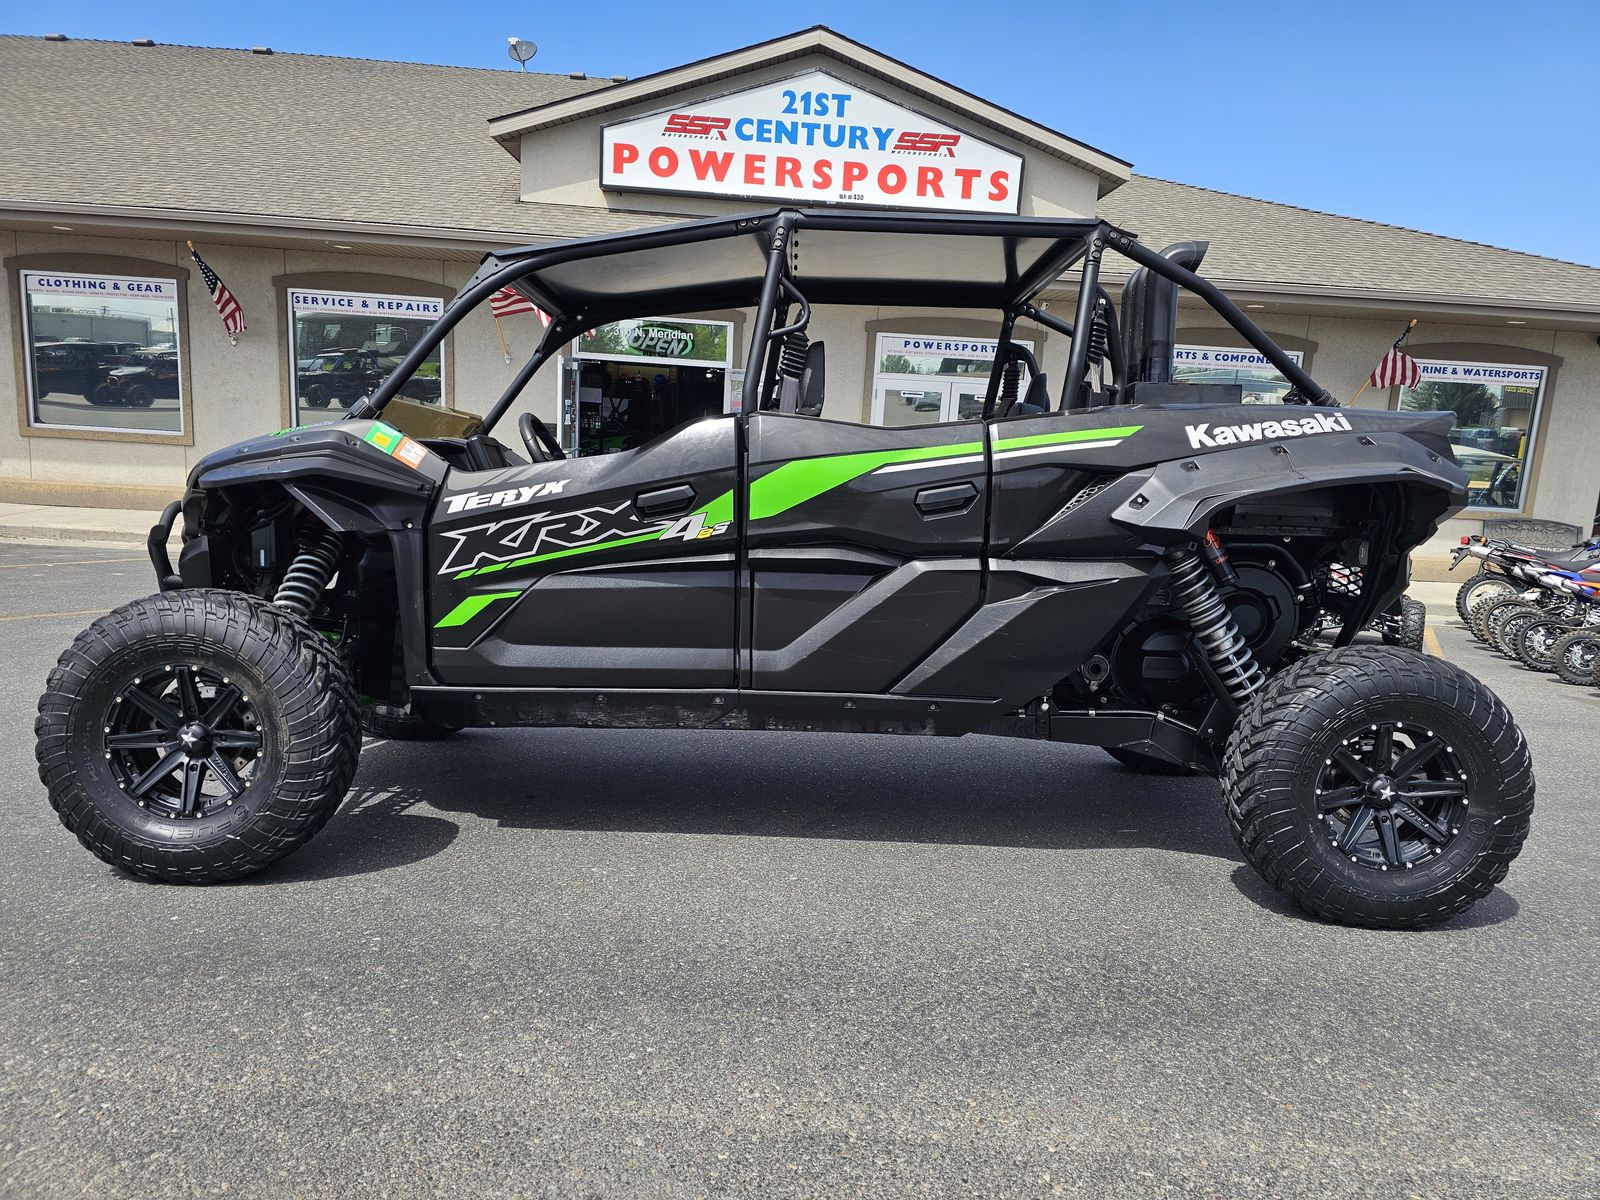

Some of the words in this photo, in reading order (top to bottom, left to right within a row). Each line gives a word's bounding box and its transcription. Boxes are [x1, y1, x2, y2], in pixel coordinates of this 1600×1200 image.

[782, 89, 852, 118] 21ST
[663, 114, 731, 141] SSR
[734, 117, 895, 151] CENTURY
[893, 132, 961, 158] SSR
[612, 142, 1009, 202] POWERSPORTS
[38, 279, 106, 290] CLOTHING
[112, 282, 121, 291] &
[127, 283, 163, 293] GEAR
[294, 295, 354, 308] SERVICE
[361, 300, 370, 309] &
[377, 301, 439, 313] REPAIRS
[628, 331, 687, 356] OPEN
[635, 327, 646, 338] N.
[649, 328, 694, 340] Meridian
[904, 341, 998, 353] POWERSPORT
[1174, 351, 1198, 360] RTS
[1202, 352, 1210, 361] &
[1418, 365, 1449, 376] RINE
[1451, 367, 1459, 376] &
[1463, 367, 1541, 380] WATERSPORTS
[1184, 412, 1353, 449] Kawasaki
[443, 479, 571, 514] TERYX
